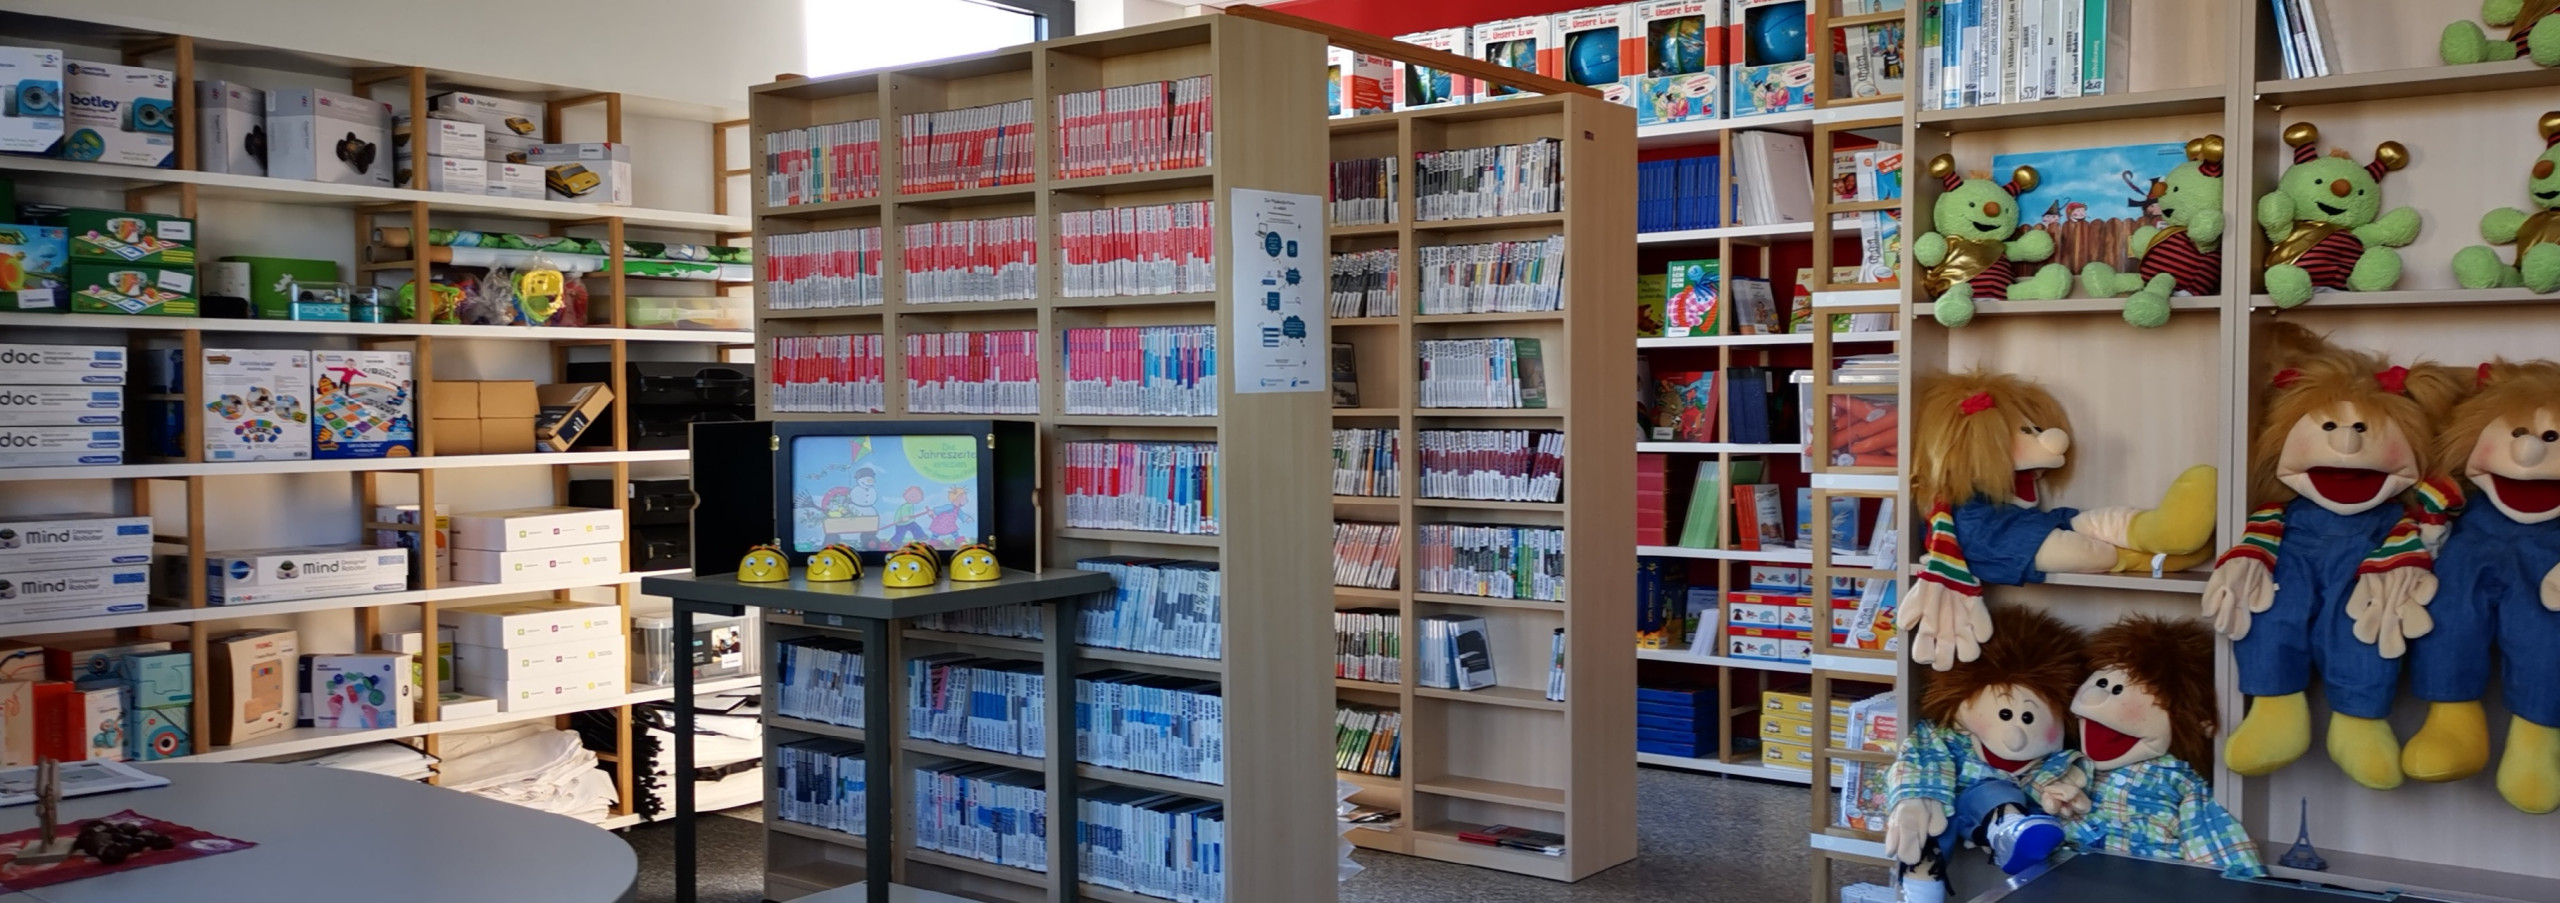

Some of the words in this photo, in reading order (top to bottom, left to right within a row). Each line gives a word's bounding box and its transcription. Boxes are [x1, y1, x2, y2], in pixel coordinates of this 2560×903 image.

[1655, 7, 1681, 17] Unsere
[1573, 19, 1597, 28] Unsere
[1492, 30, 1516, 40] Unsere
[70, 93, 120, 112] botley
[1, 349, 40, 364] doc
[0, 391, 38, 406] doc
[0, 432, 38, 448] doc
